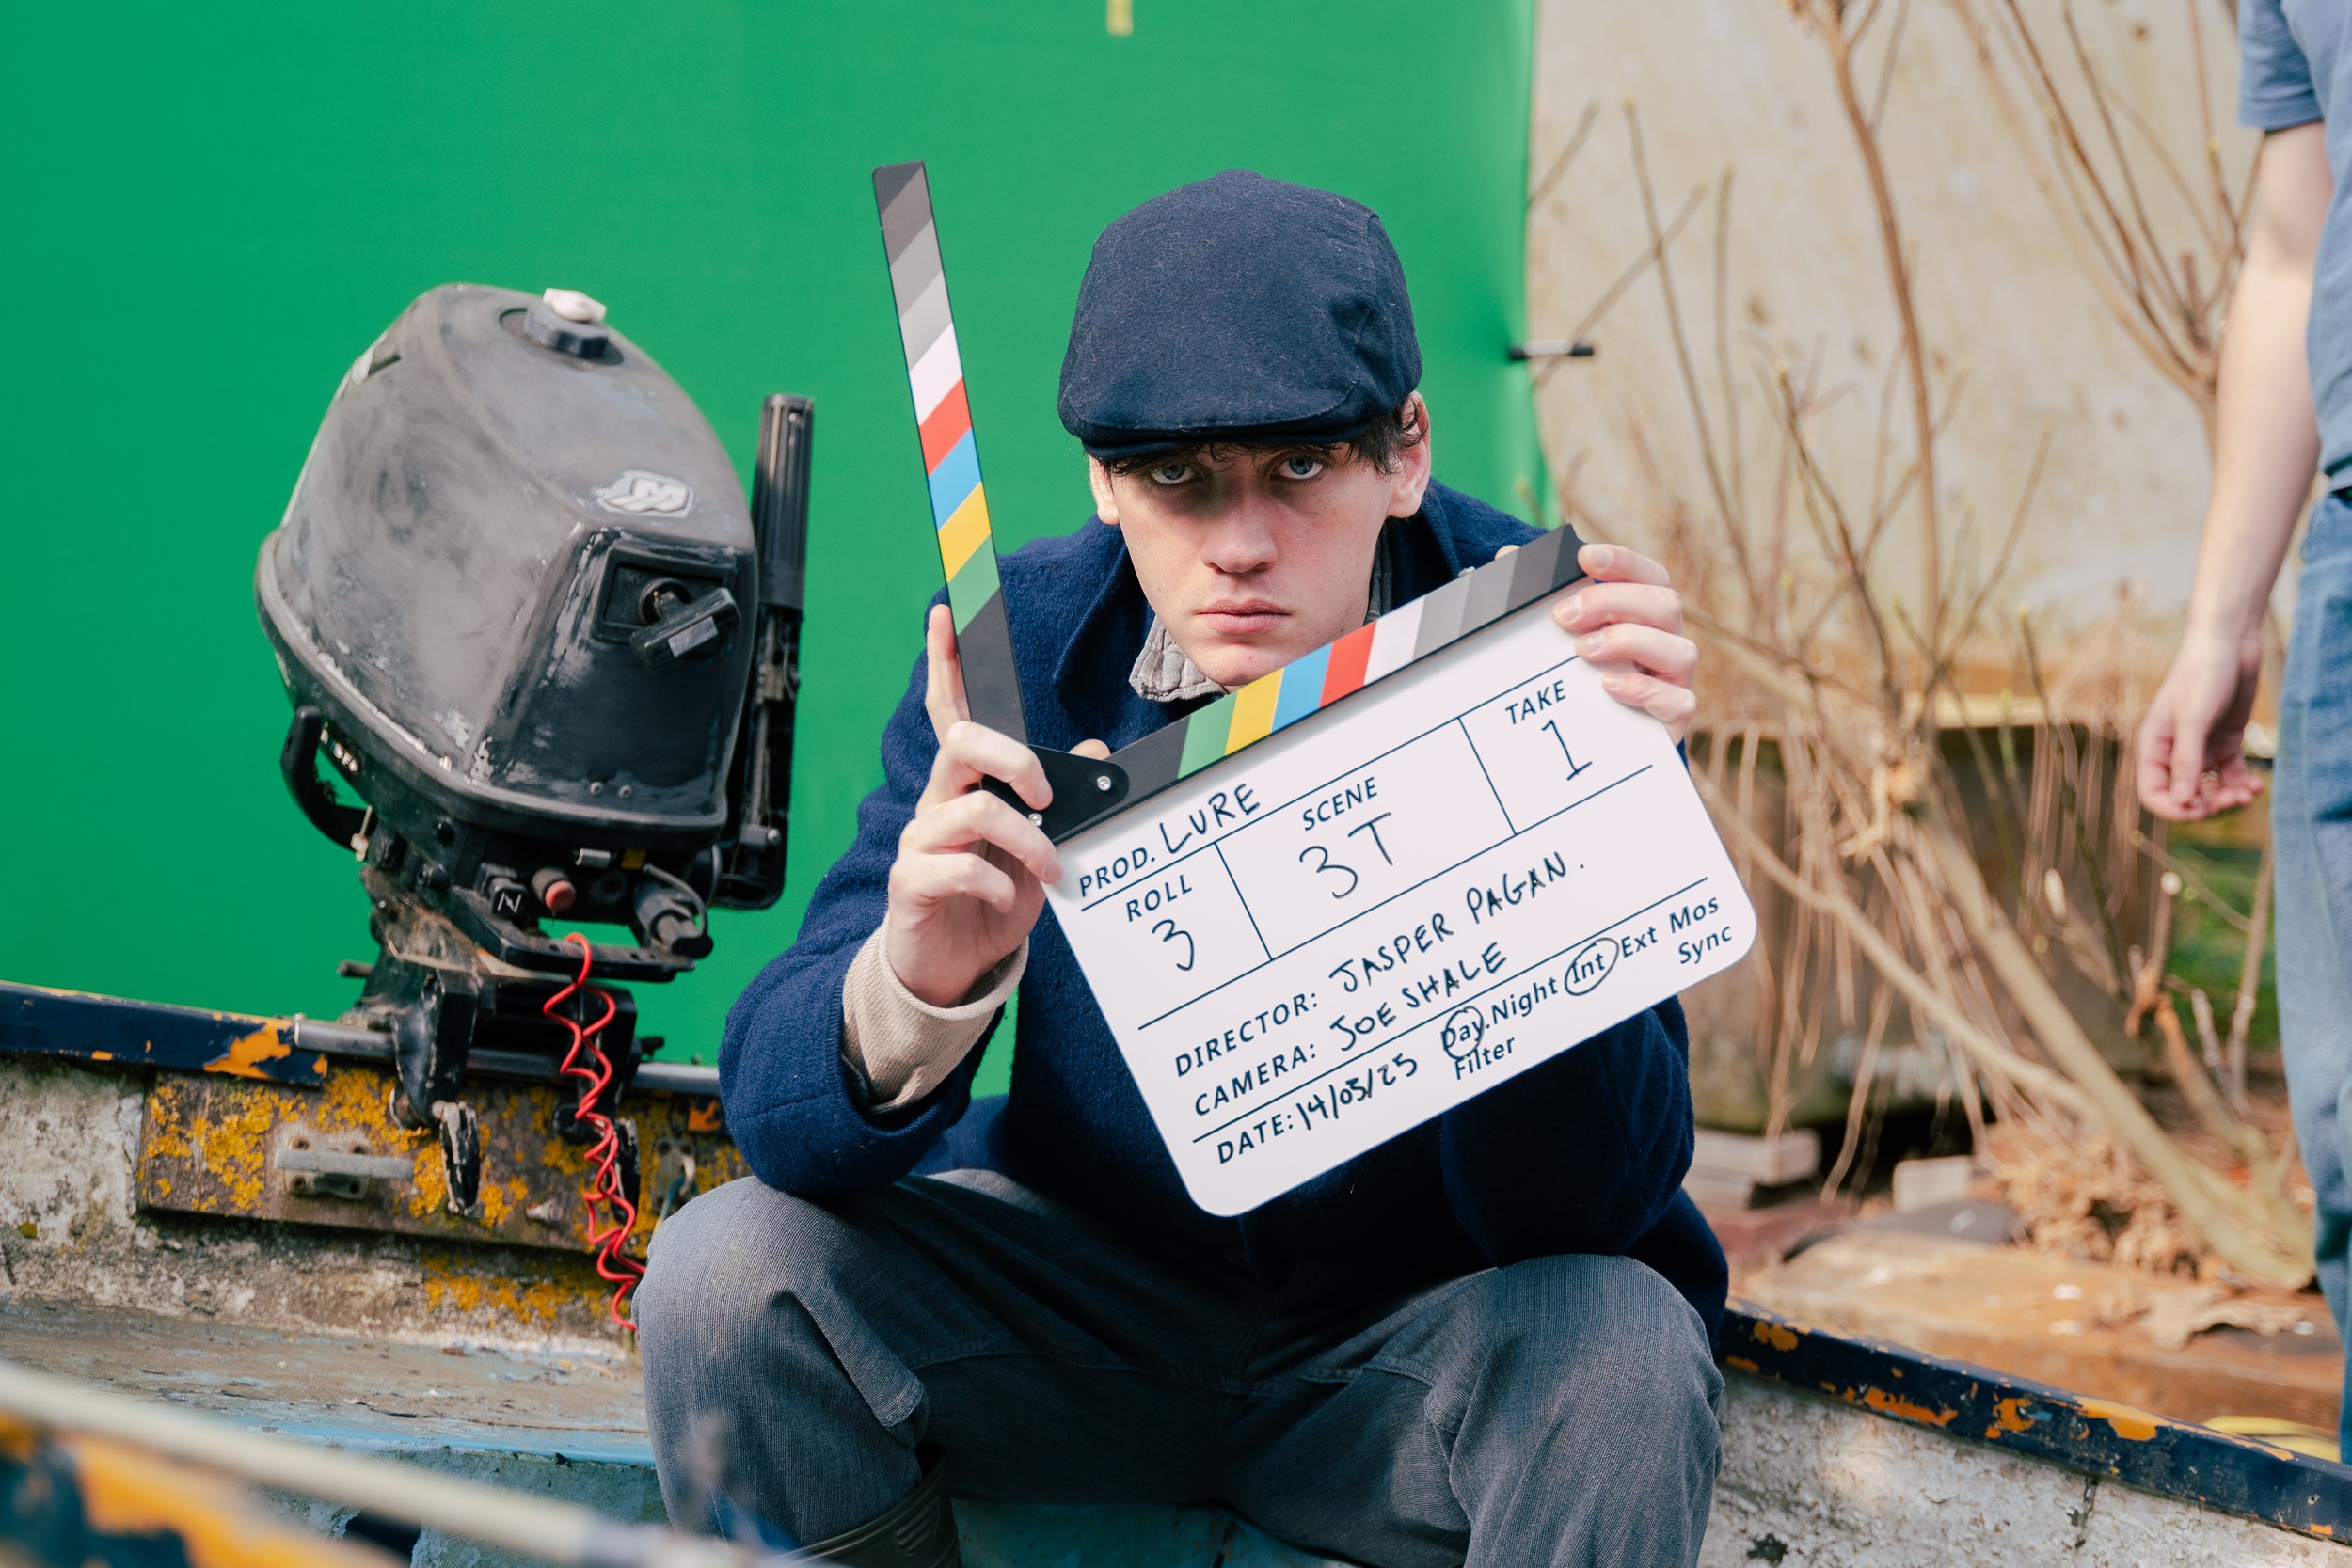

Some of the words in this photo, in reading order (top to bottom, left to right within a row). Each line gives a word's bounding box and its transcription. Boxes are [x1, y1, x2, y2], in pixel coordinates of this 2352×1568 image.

[1504, 679, 1567, 725] TAKE
[1541, 718, 1594, 782] 1
[1301, 776, 1378, 832] SCENE
[1078, 847, 1156, 898] PROD.
[1159, 782, 1261, 855] LURE
[1125, 873, 1193, 923] ROLL
[1151, 918, 1196, 973] 3
[1490, 976, 1559, 1025] Night
[1568, 952, 1607, 985] Int
[1619, 925, 1659, 958] Ext
[1668, 896, 1720, 934] Mos
[1677, 926, 1734, 965] Sync
[1174, 991, 1319, 1078] DIRECTOR:
[1327, 912, 1454, 993] JASPER
[1193, 1042, 1317, 1117] CAMERA:
[1328, 1001, 1397, 1053] JOE
[1401, 941, 1508, 1008] SHALE
[1454, 1036, 1516, 1081] Filter
[1216, 1112, 1295, 1165] DATE:
